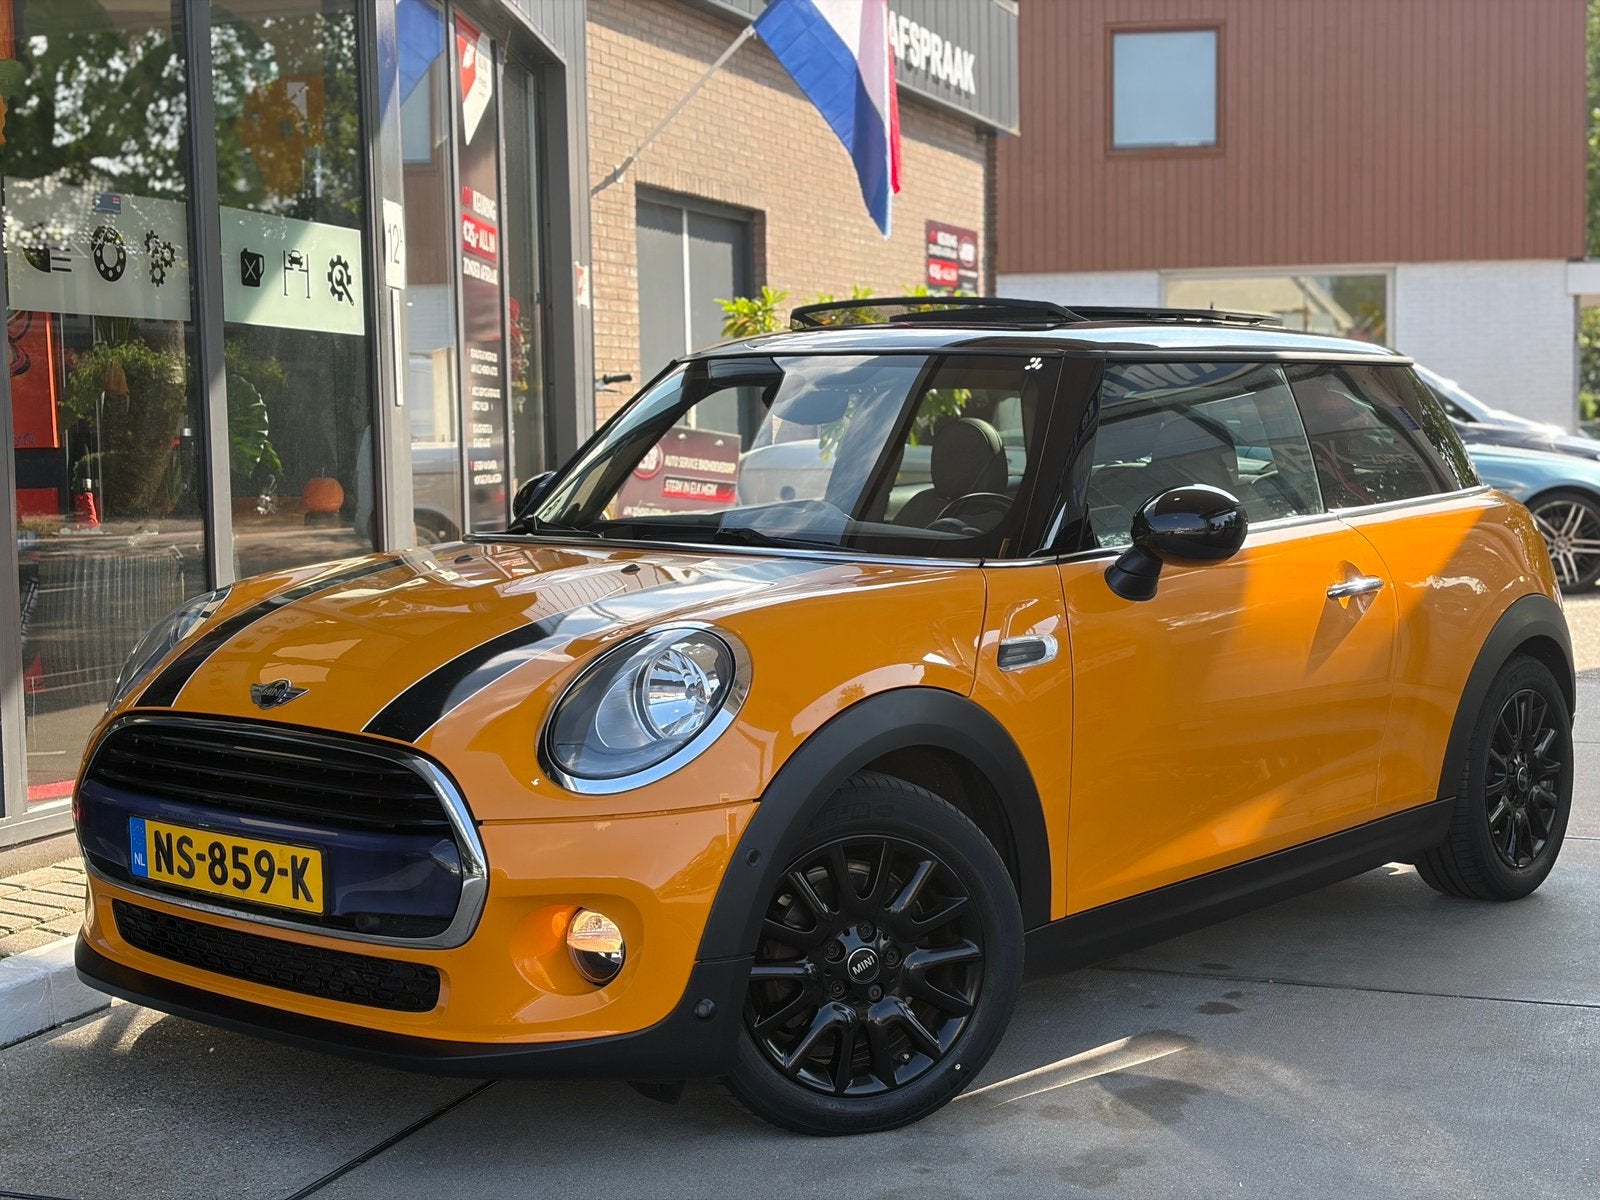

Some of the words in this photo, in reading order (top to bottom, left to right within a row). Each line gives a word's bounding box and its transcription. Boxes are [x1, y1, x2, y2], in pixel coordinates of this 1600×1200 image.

[888, 10, 976, 95] AFSPRAAK
[134, 852, 146, 867] NL
[154, 830, 314, 903] NS-859-K
[851, 955, 876, 975] MINI
